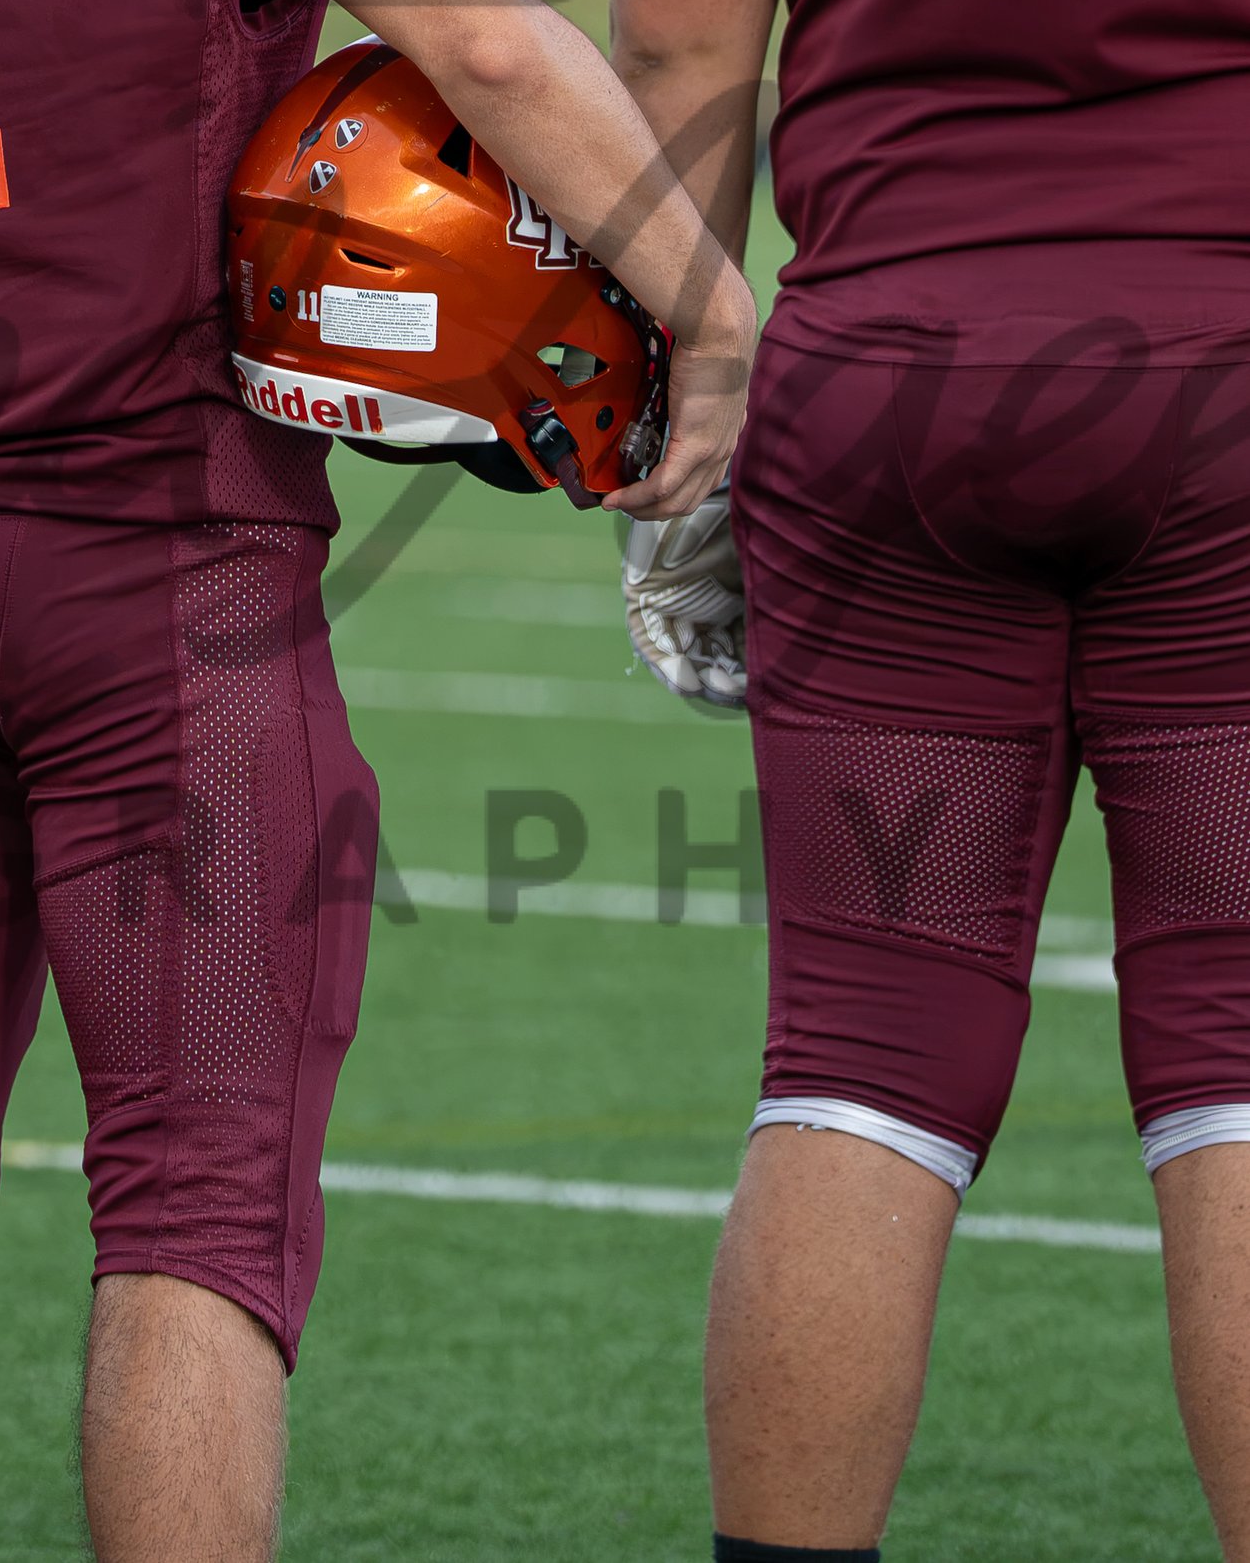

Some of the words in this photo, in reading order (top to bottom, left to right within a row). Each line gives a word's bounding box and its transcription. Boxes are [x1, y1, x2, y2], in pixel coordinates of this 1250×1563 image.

[297, 289, 320, 322] 11
[356, 290, 399, 302] WARNING
[233, 363, 384, 435] Riddell
